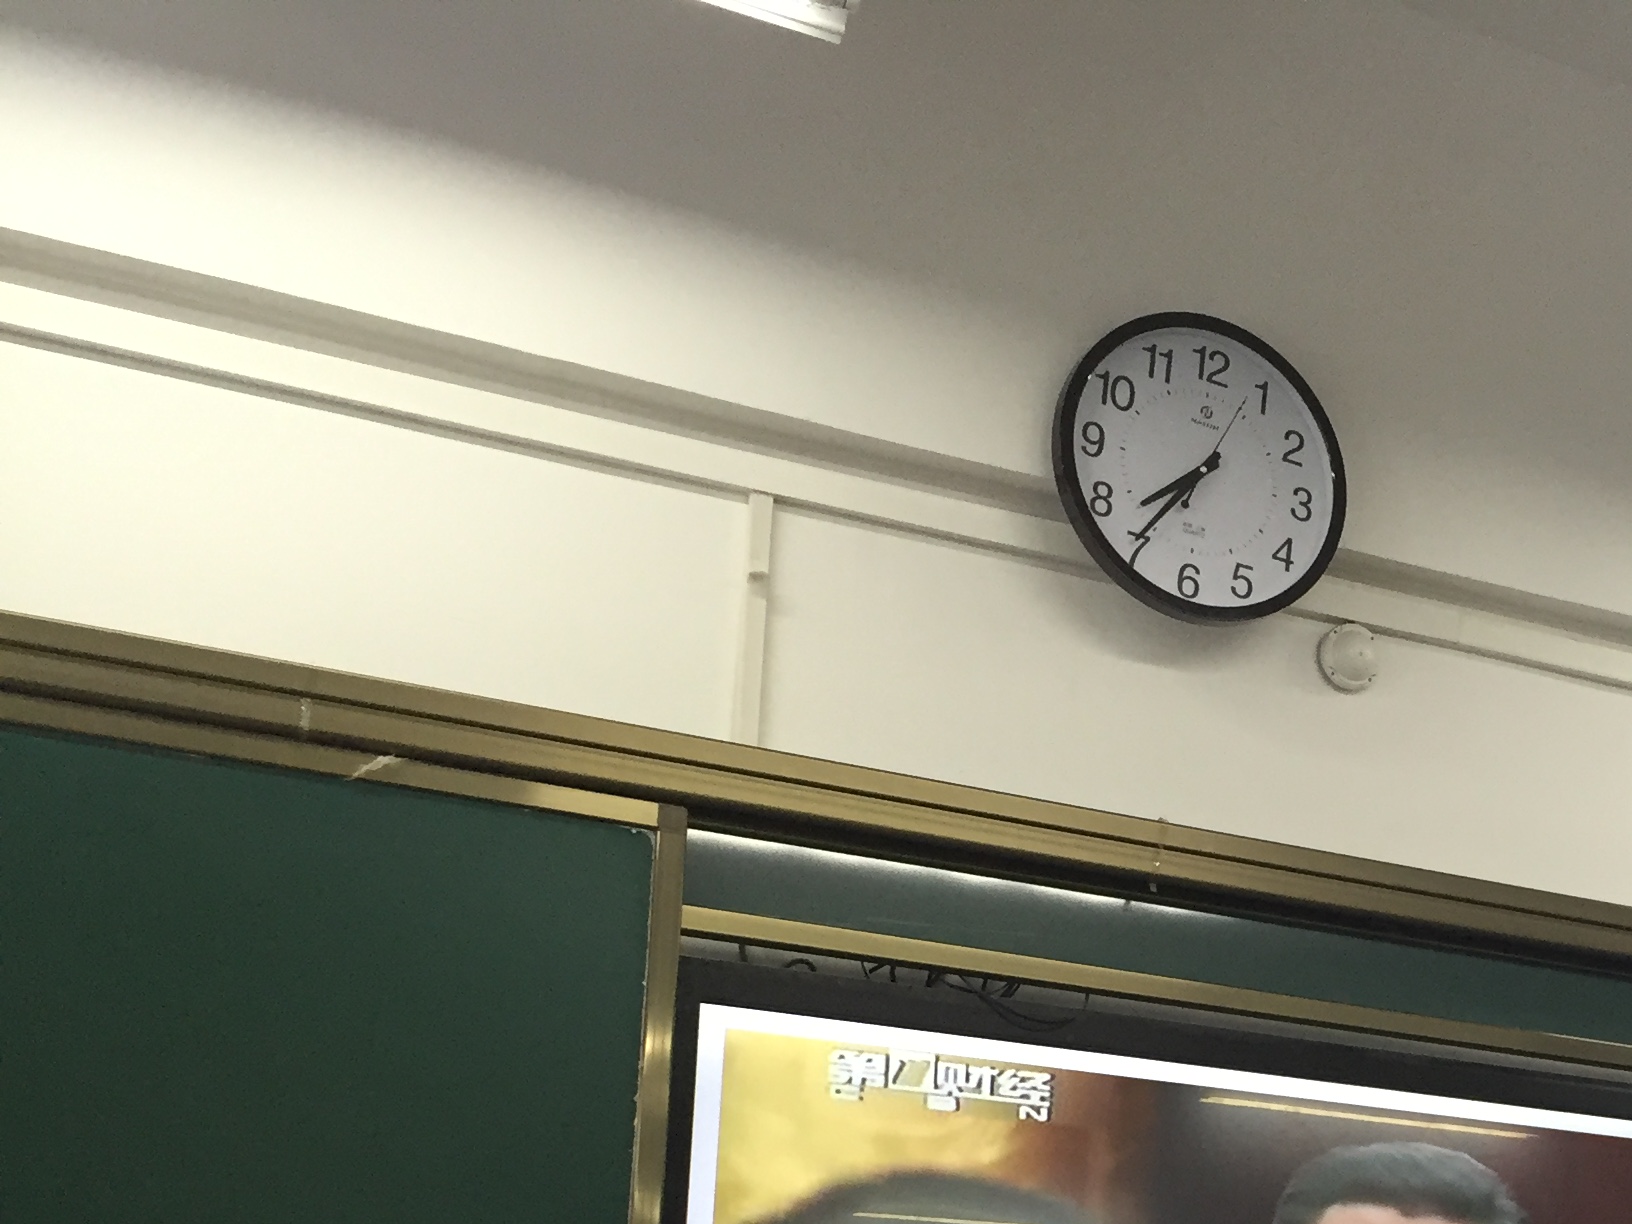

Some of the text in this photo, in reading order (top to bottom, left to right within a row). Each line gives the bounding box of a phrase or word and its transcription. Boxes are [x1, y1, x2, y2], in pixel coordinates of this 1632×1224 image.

[1142, 344, 1173, 384] 11
[1192, 346, 1231, 389] 12
[1095, 370, 1135, 411] 10
[1254, 381, 1269, 415] 1
[1081, 421, 1105, 458] 9
[1282, 429, 1304, 467] 2
[1090, 481, 1113, 517] 8
[1290, 487, 1313, 522] 3
[1127, 530, 1150, 567] 7
[1272, 538, 1295, 572] 4
[1177, 563, 1200, 599] 6
[1230, 562, 1253, 600] 5
